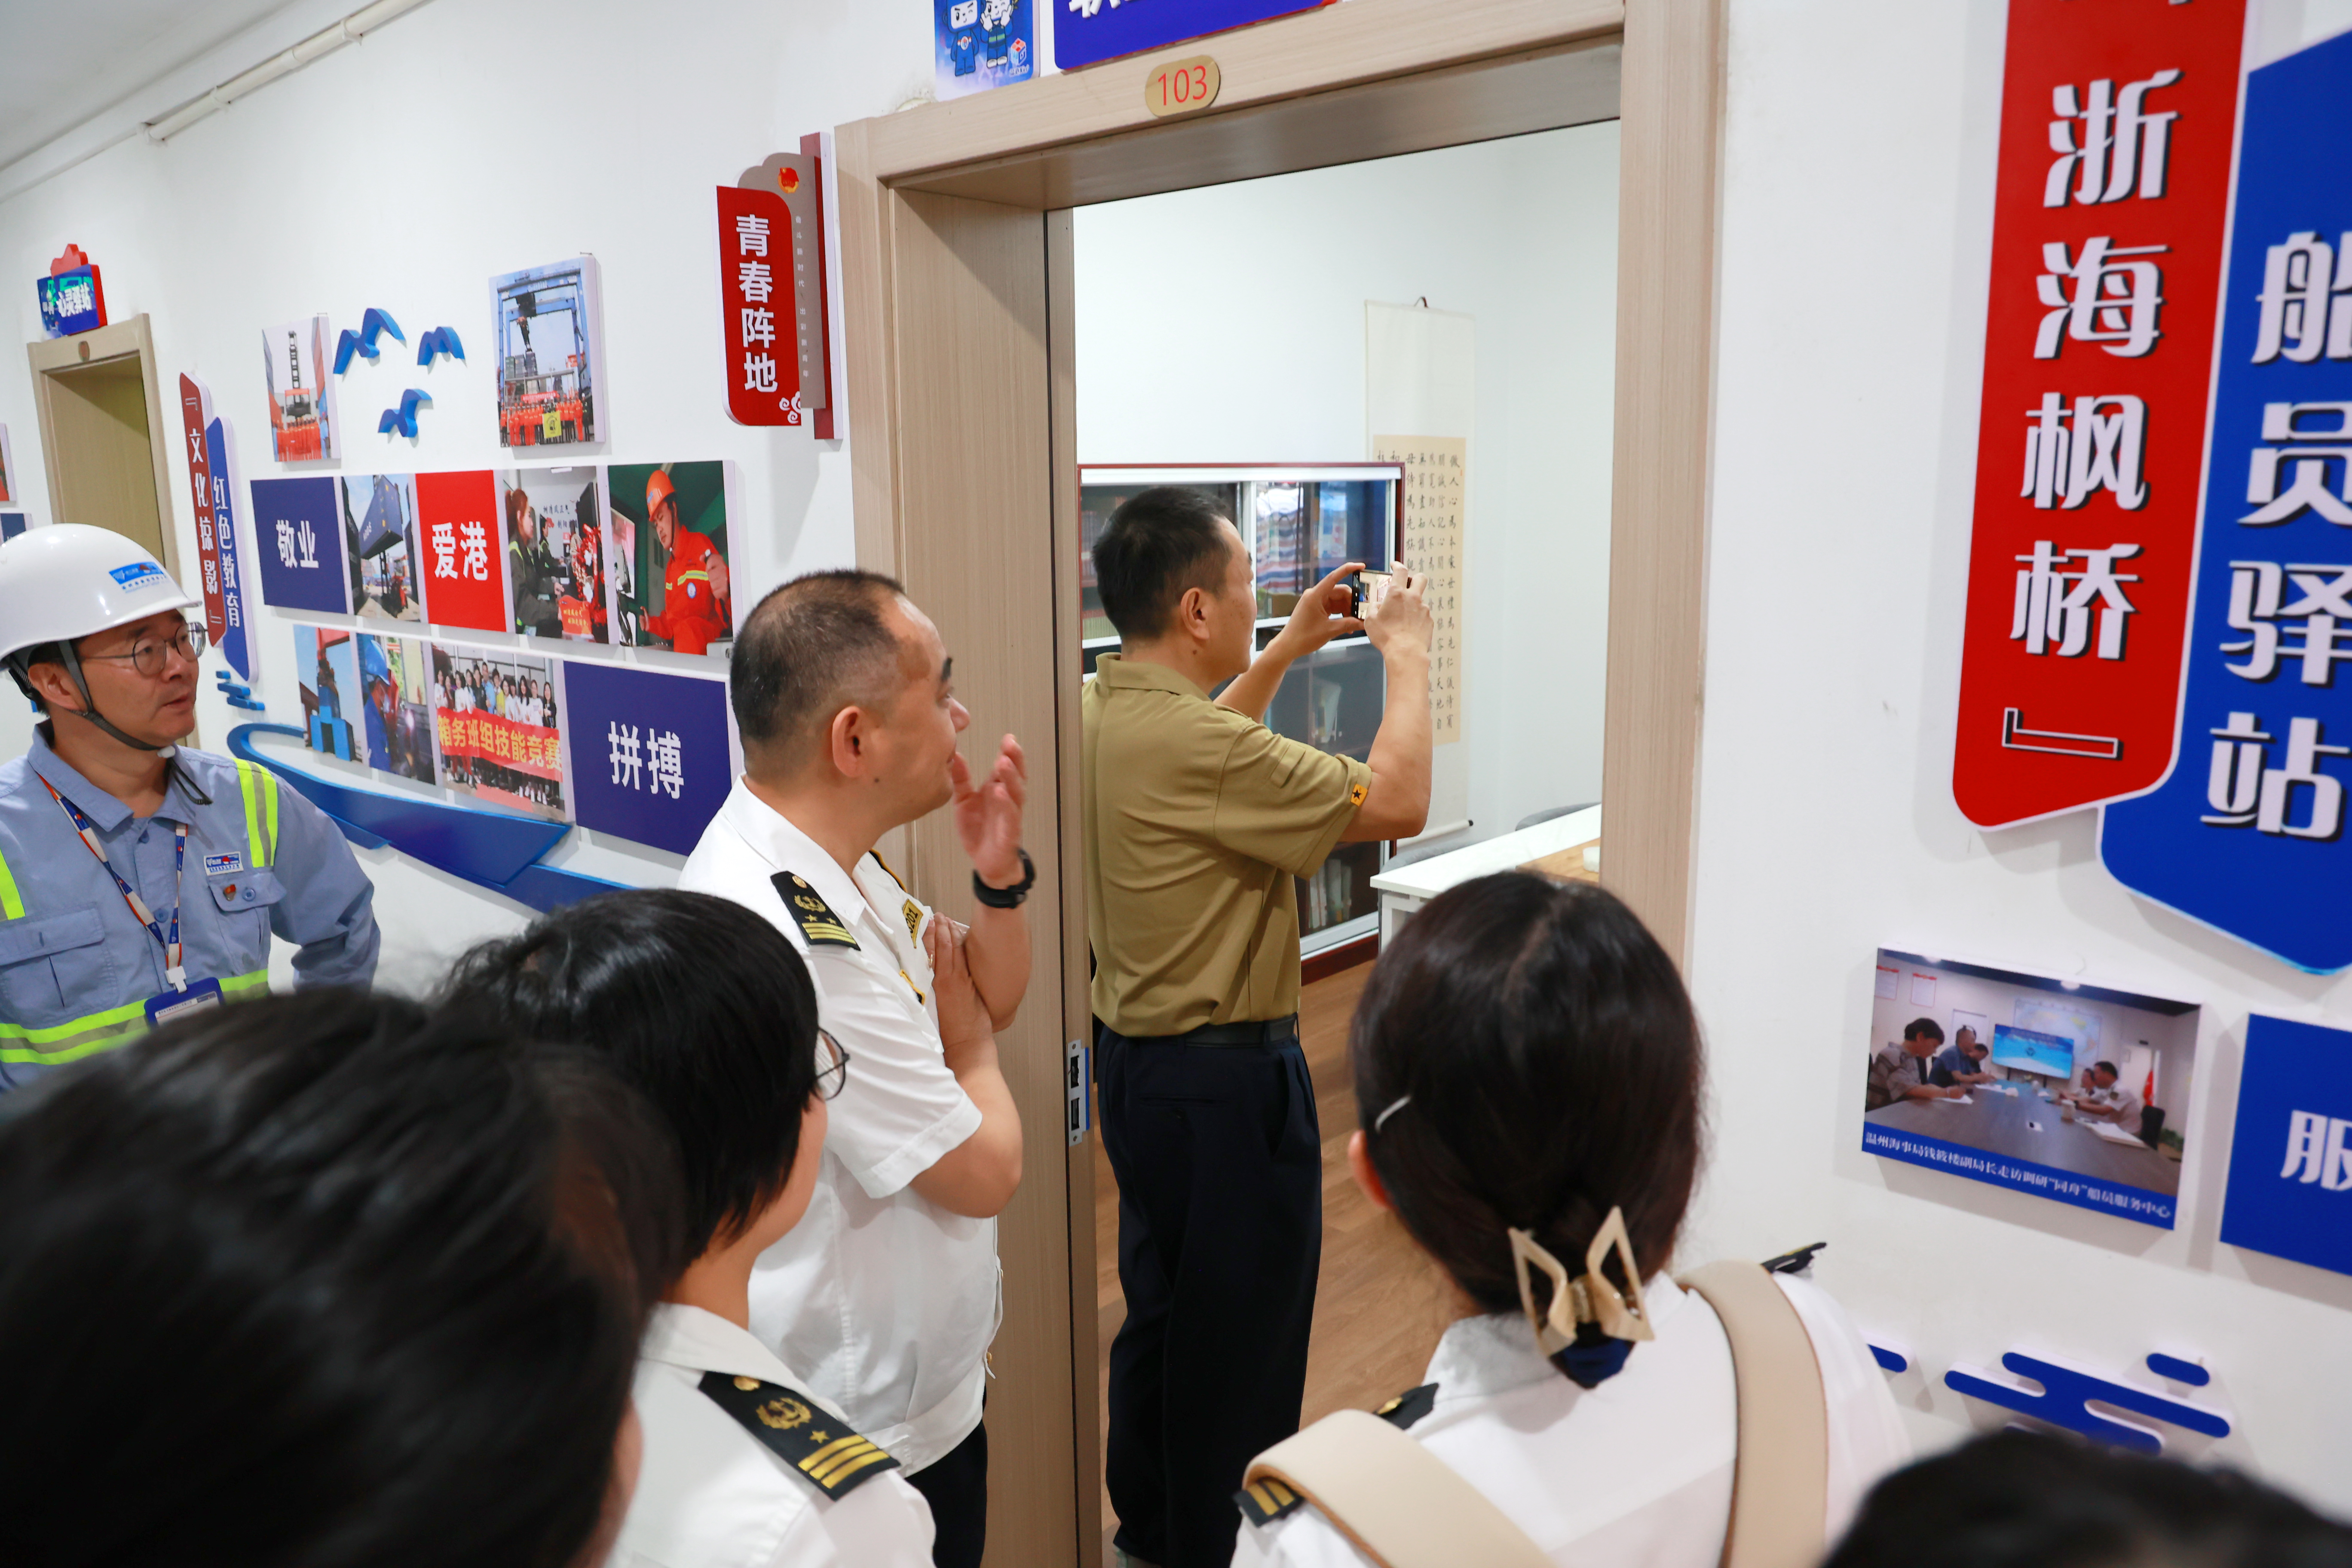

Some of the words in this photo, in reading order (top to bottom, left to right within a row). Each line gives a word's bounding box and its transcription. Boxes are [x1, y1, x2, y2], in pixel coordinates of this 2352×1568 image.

[1158, 65, 1207, 106] 103
[736, 214, 778, 393] 青春阵地
[214, 475, 240, 628] 红色教育
[276, 519, 319, 569] 敬业
[432, 521, 489, 581] 爱港
[2200, 231, 2352, 839] 船员驿站
[437, 715, 563, 772] 箱务班组技能竞赛
[607, 720, 684, 799] 拼搏
